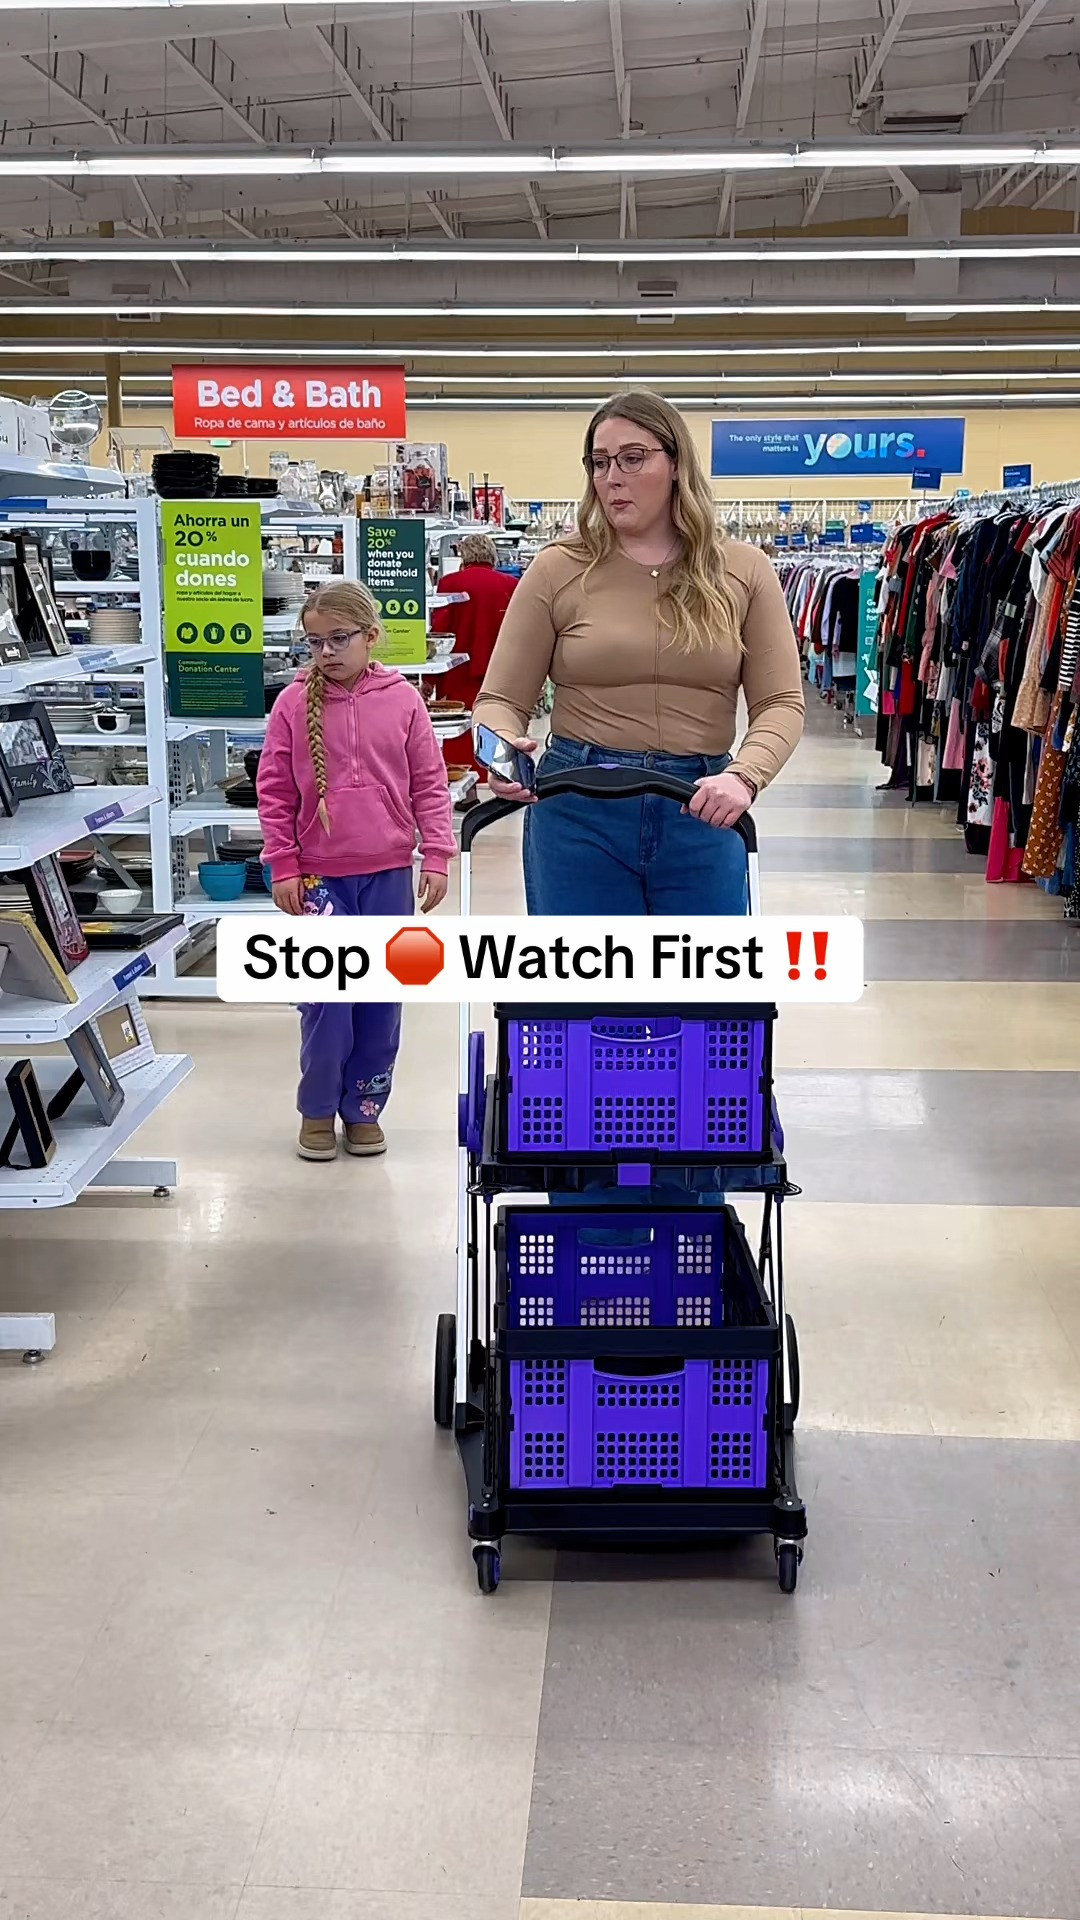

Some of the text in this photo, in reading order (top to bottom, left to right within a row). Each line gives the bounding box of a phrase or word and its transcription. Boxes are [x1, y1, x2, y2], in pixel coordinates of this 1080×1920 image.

[197, 379, 382, 408] Bed & Bath
[194, 417, 386, 431] Ropa de cama y artículos de baño
[729, 434, 799, 443] The only style that
[762, 445, 791, 453] matters
[174, 513, 250, 527] Ahorra un
[367, 526, 397, 537] Save
[174, 531, 218, 547] 20%
[367, 538, 392, 549] 20%
[175, 550, 250, 567] cuando
[367, 549, 415, 560] when you
[367, 559, 402, 568] donate
[175, 569, 237, 587] dones
[367, 568, 418, 578] household
[367, 577, 395, 587] items
[178, 665, 240, 673] Donation Center
[10, 773, 38, 789] Family
